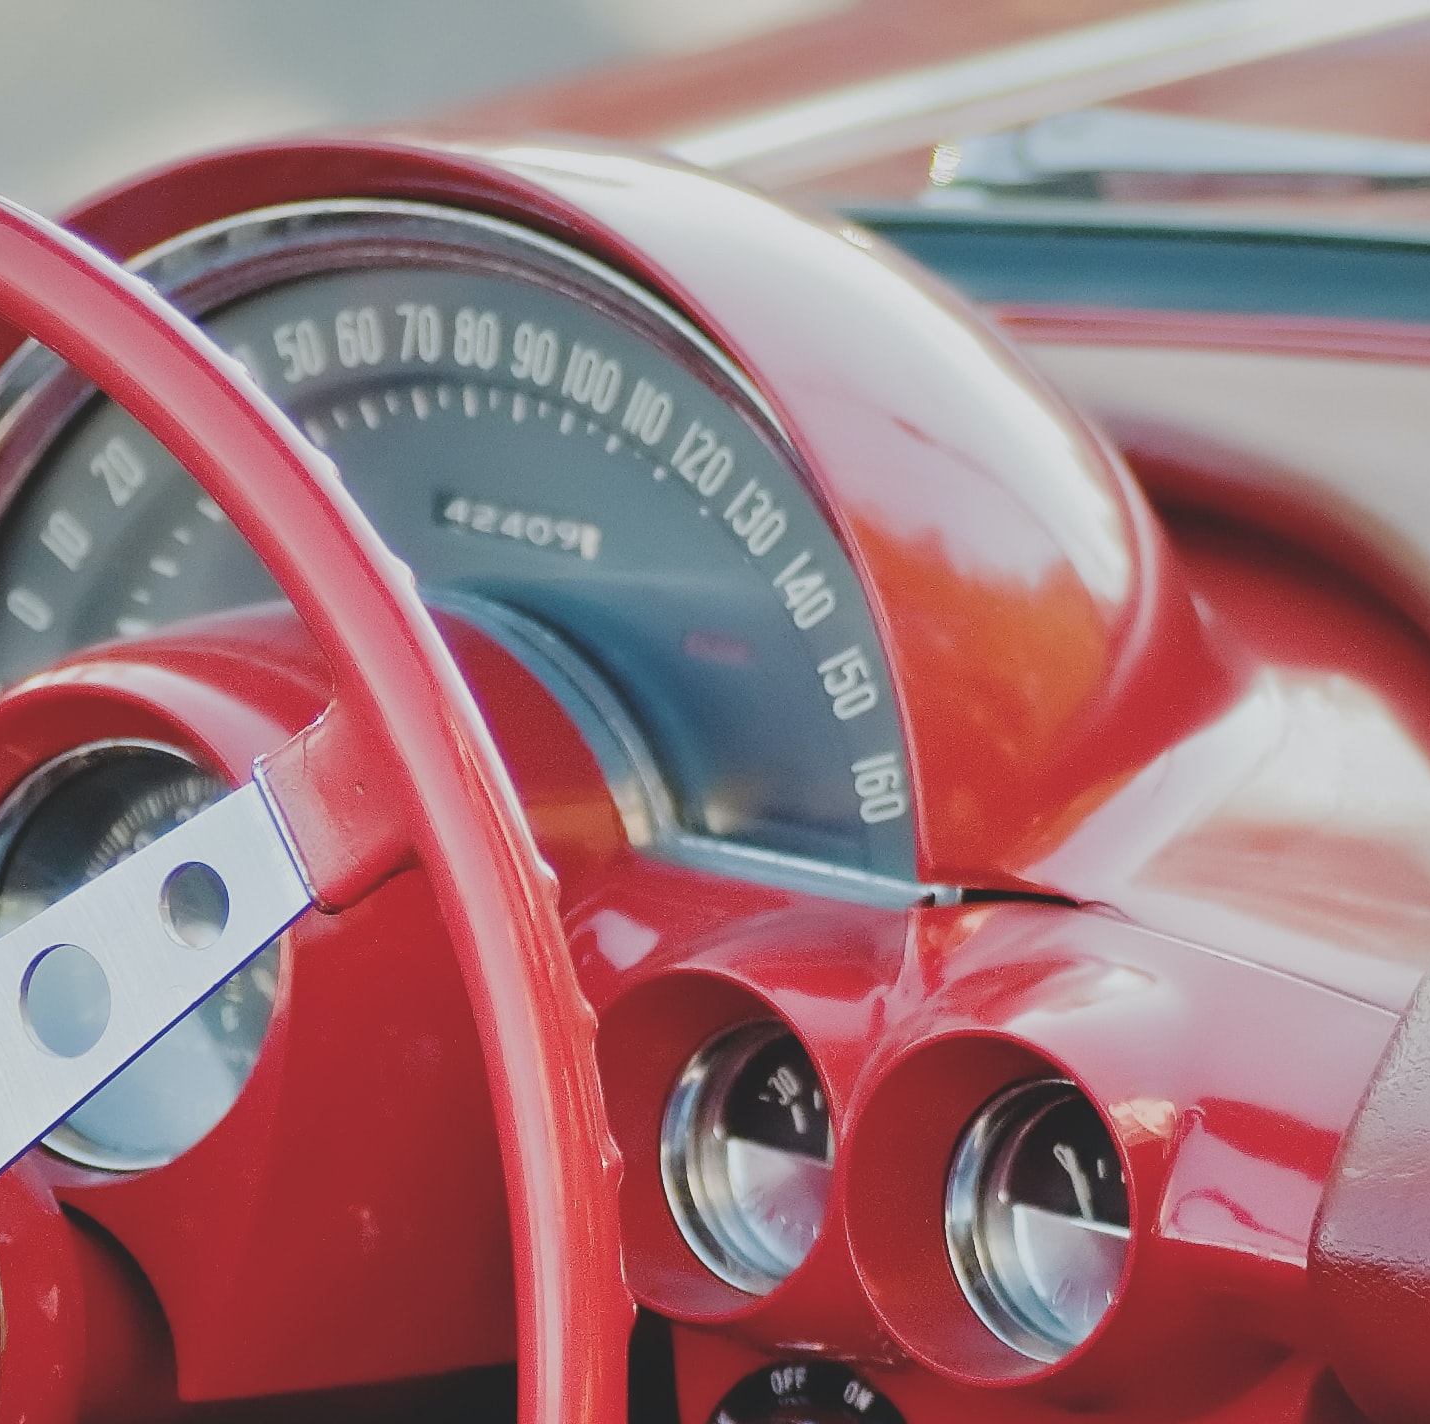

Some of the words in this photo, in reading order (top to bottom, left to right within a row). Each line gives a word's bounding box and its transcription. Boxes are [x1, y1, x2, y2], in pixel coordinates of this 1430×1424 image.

[7, 588, 53, 632] 0
[40, 510, 92, 572] 10
[90, 436, 146, 508] 20
[273, 319, 327, 383] 50
[335, 307, 384, 368] 60
[396, 303, 442, 363] 70
[454, 308, 502, 370] 80
[511, 323, 558, 386] 90
[562, 341, 622, 414] 100
[622, 377, 673, 446] 110
[671, 420, 734, 498] 120
[723, 478, 789, 557] 130
[772, 550, 835, 630] 140
[817, 645, 878, 721] 150
[850, 751, 906, 824] 160
[770, 1366, 807, 1396] OFF
[843, 1380, 875, 1413] ON
